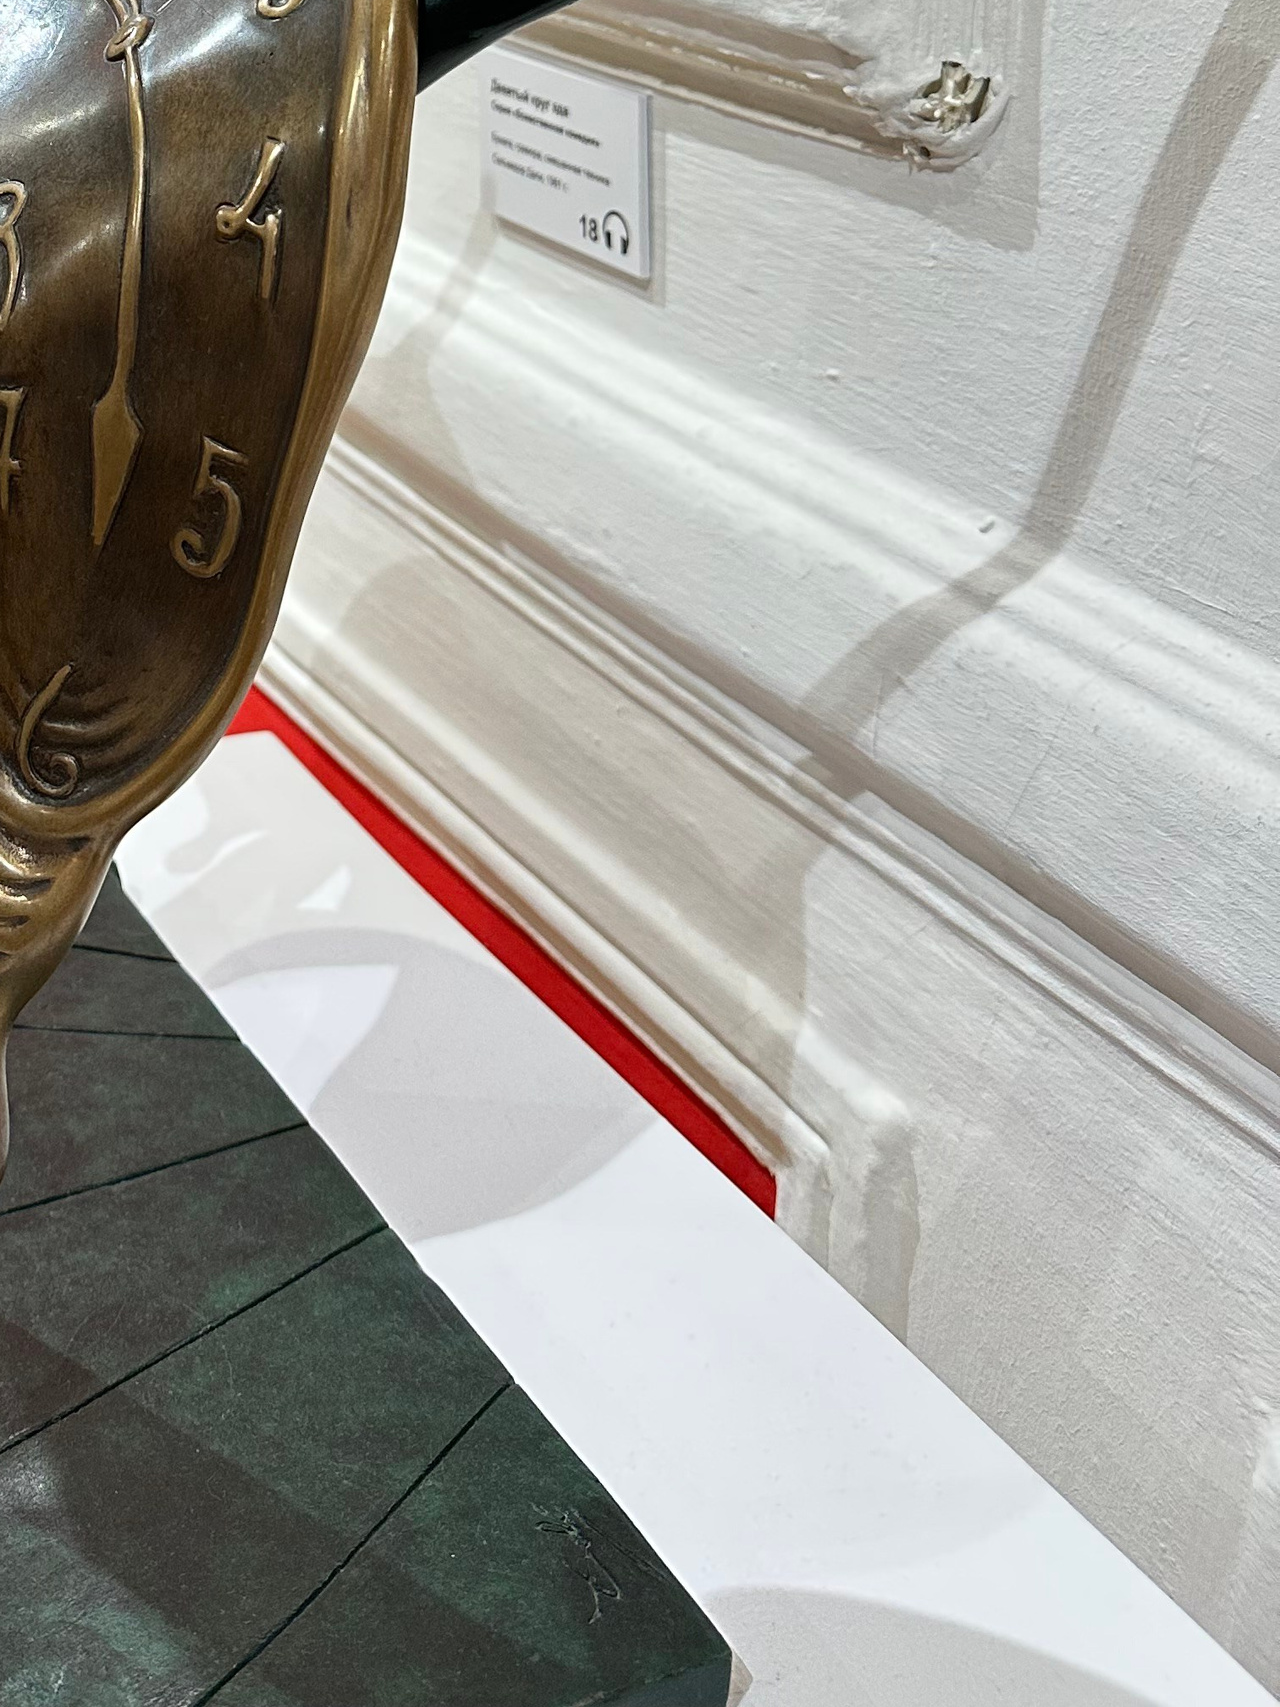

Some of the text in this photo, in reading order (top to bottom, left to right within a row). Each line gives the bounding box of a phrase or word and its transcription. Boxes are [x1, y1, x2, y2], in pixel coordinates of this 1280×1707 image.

[216, 136, 286, 300] 4
[579, 214, 598, 242] 18
[170, 436, 249, 579] 5
[18, 661, 78, 796] 6
